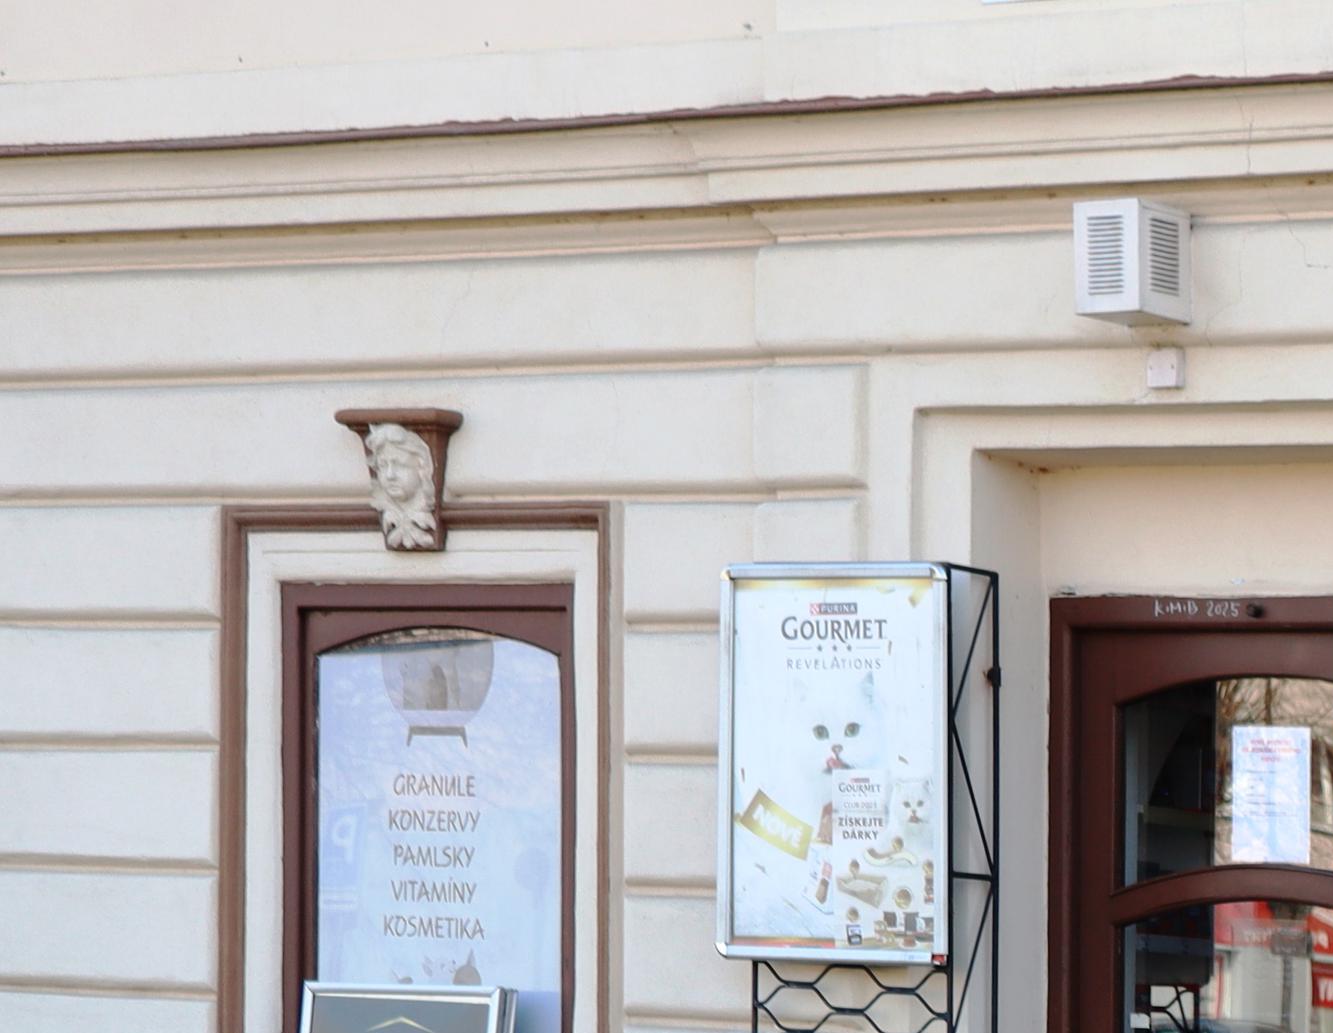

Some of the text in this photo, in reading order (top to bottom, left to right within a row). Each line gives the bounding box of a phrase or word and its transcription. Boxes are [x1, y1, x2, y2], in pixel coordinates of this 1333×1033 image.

[1206, 600, 1240, 617] 2025
[781, 616, 887, 643] GOURMET
[787, 656, 882, 670] REVELATIONS
[393, 773, 476, 797] GRANULE
[388, 810, 480, 833] KONZERVY
[838, 814, 884, 827] ZÍSKEJTE
[842, 828, 879, 841] DÁRKY
[393, 845, 475, 868] PAMLSKY
[391, 877, 476, 904] VITAMÍNY
[383, 914, 485, 940] KOSMETIKA
